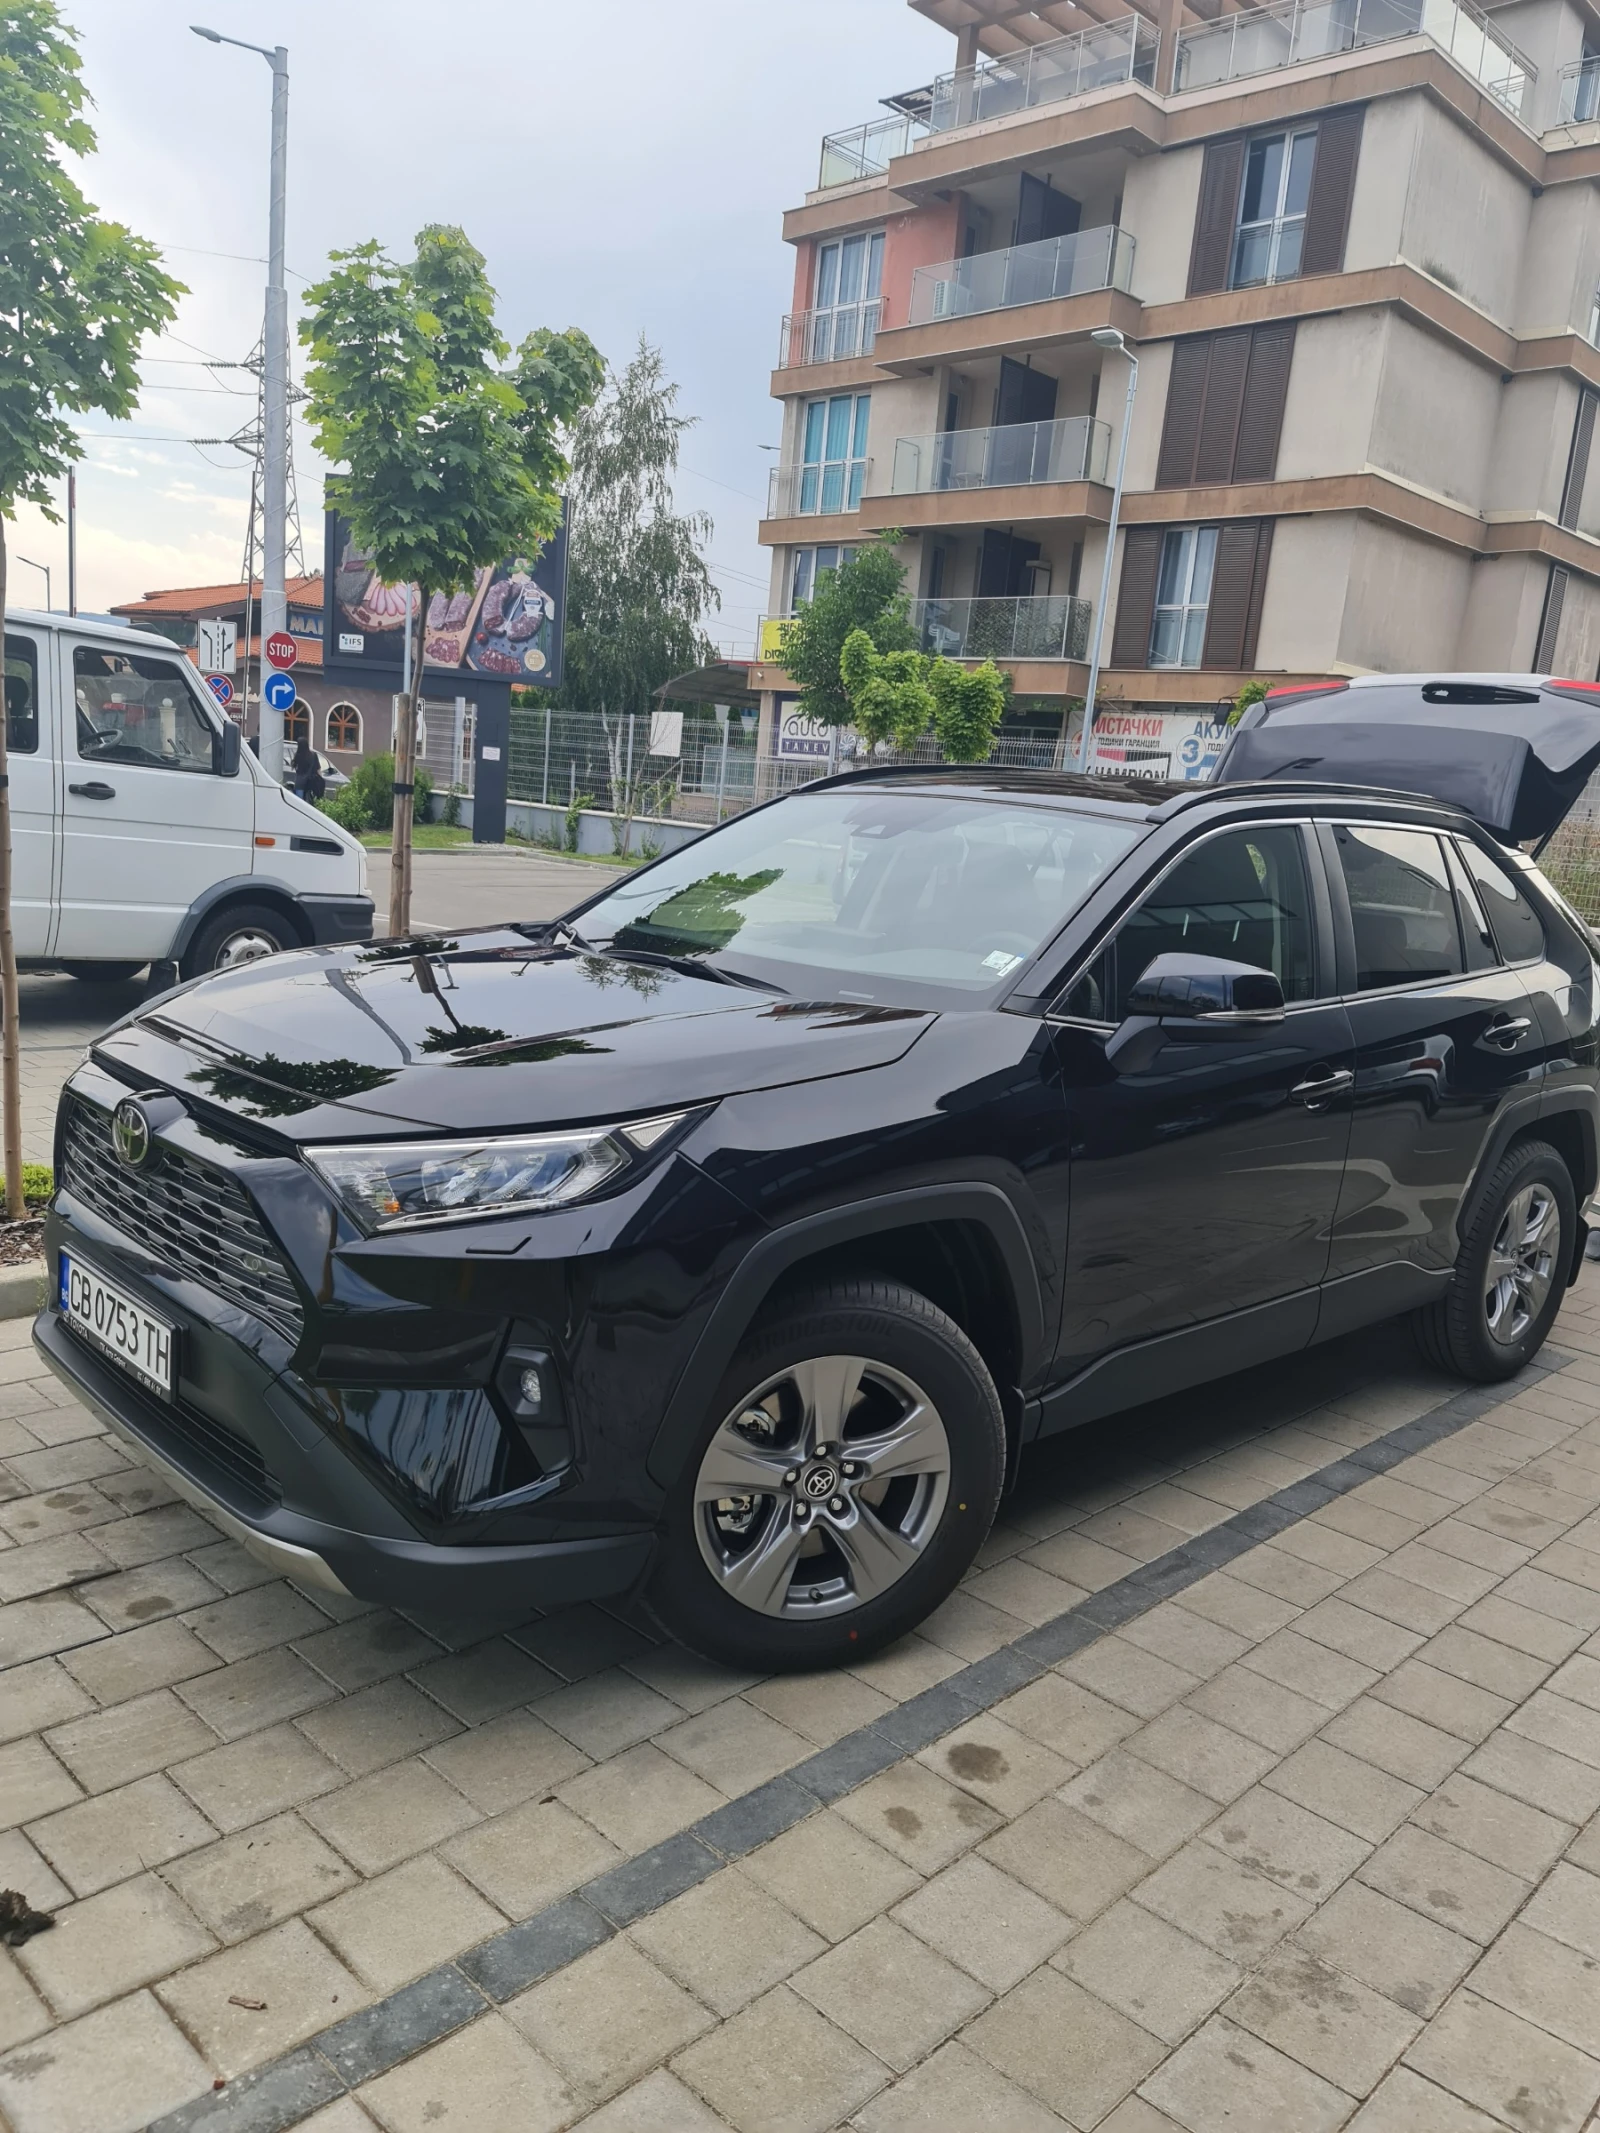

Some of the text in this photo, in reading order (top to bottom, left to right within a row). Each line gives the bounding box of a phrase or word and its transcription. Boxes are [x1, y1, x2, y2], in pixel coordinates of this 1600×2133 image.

[269, 642, 294, 658] STOP
[787, 718, 829, 737] auto
[1091, 716, 1164, 737] ИСТАЧКИ
[785, 741, 829, 753] TANEV
[1097, 737, 1124, 747] ГОДИНИ
[1125, 738, 1160, 749] ГАРАНЦИЯ
[1182, 739, 1224, 763] 3 ГОД
[61, 1287, 69, 1303] BG
[70, 1316, 89, 1340] TOYOTA
[95, 1288, 138, 1356] 0753
